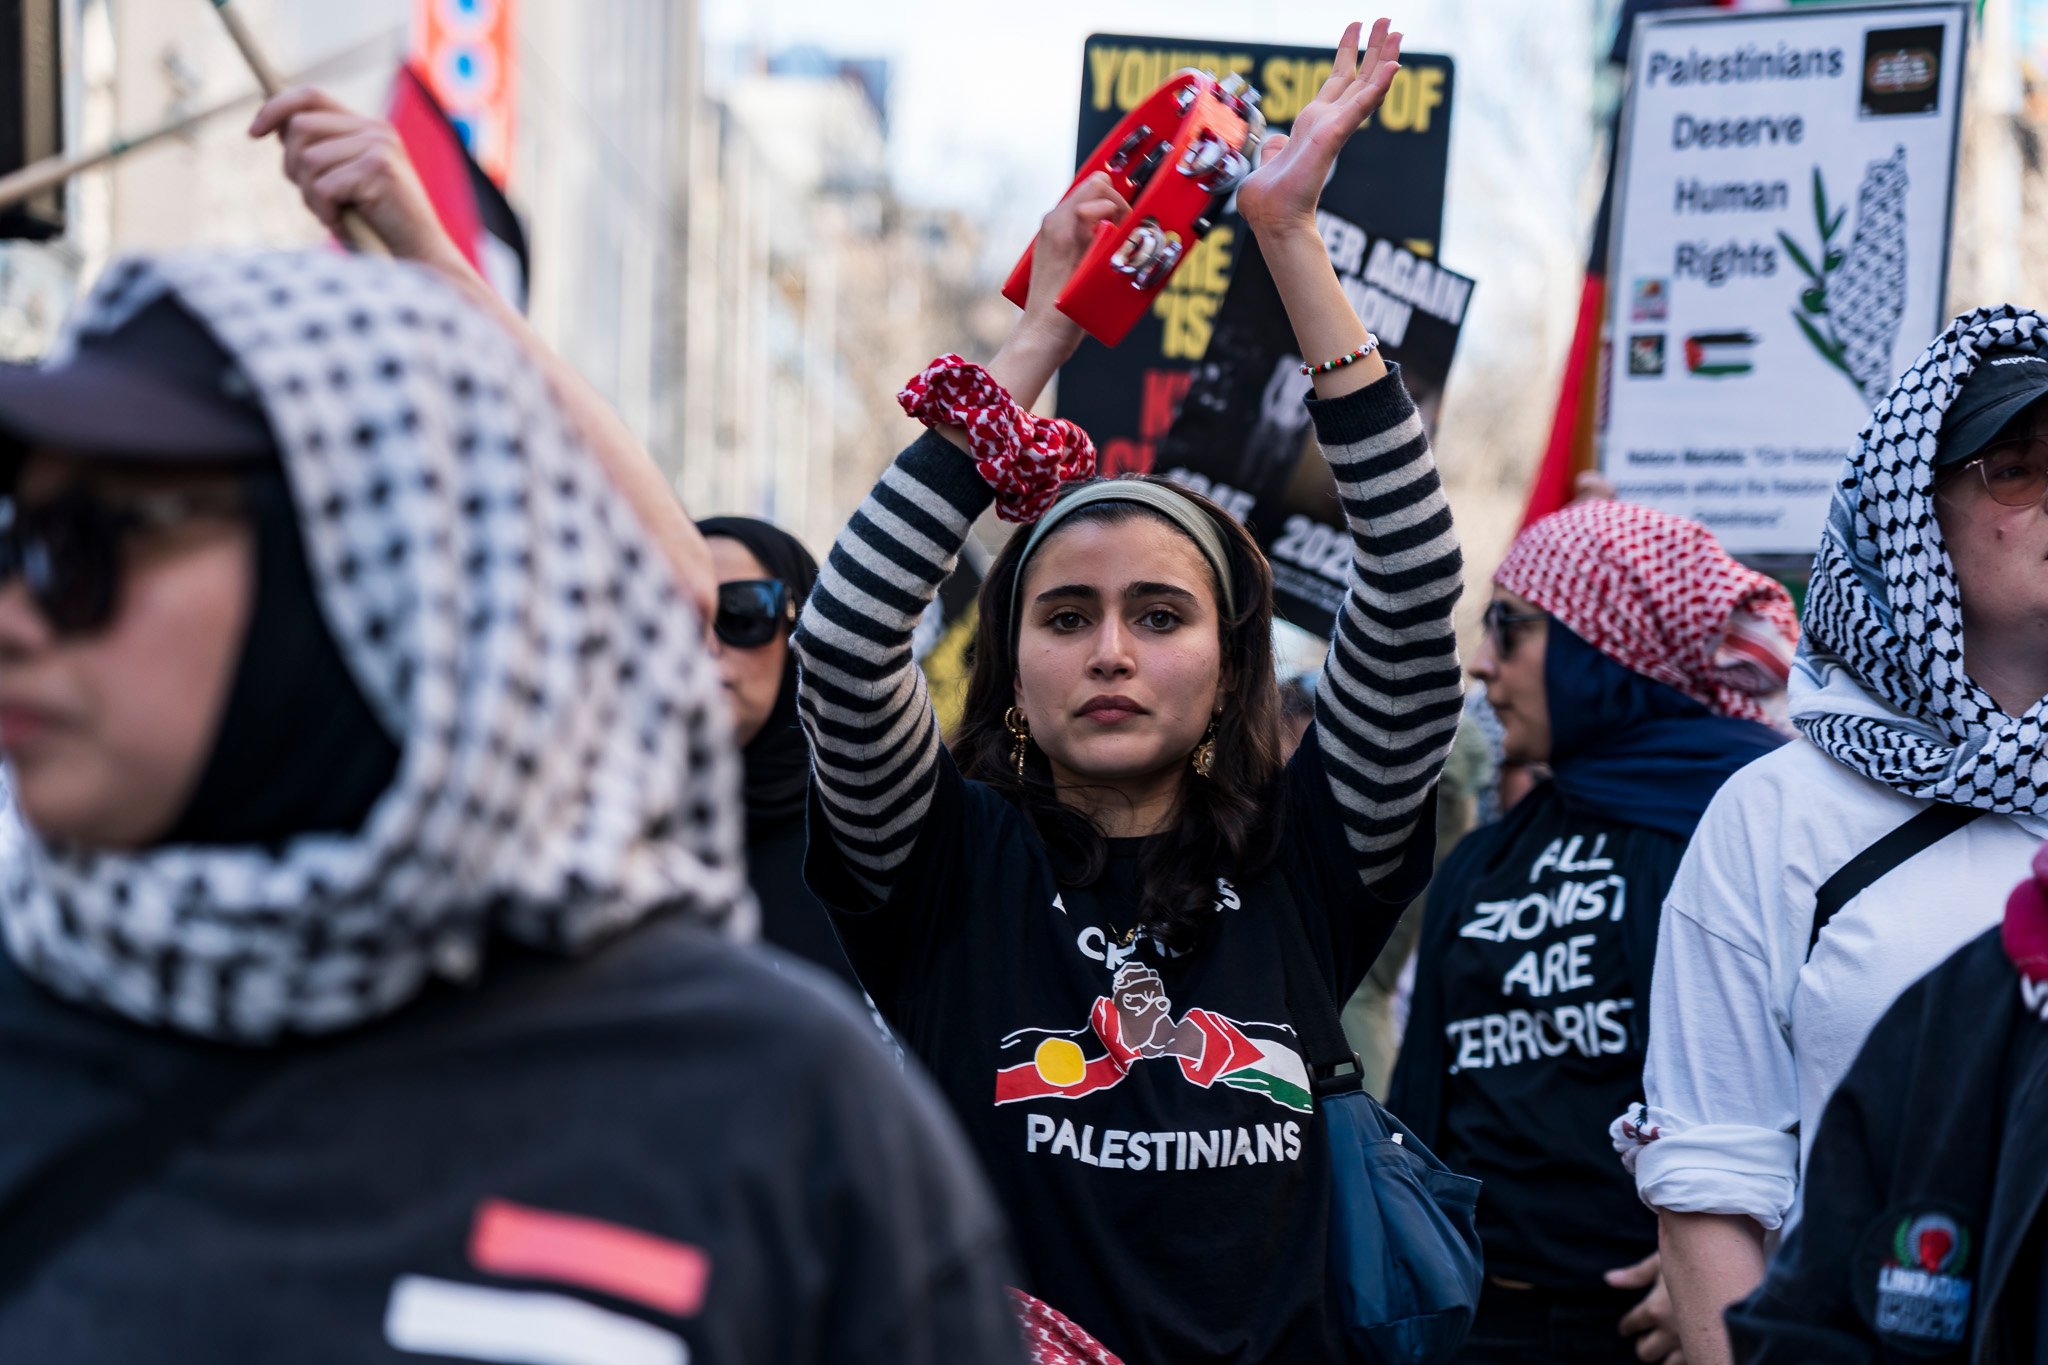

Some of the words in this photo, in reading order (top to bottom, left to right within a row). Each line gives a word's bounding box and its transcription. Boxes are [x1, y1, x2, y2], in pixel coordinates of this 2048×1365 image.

[1647, 44, 1846, 88] Palestinians
[1378, 66, 1445, 132] OF
[1671, 114, 1804, 151] Deserve
[1675, 178, 1788, 214] Human
[1364, 238, 1471, 326] AGAIN
[1675, 240, 1780, 286] Rights
[1529, 833, 1614, 883] ALL
[1502, 934, 1596, 997] ARE
[1026, 1113, 1302, 1172] PALESTINIANS
